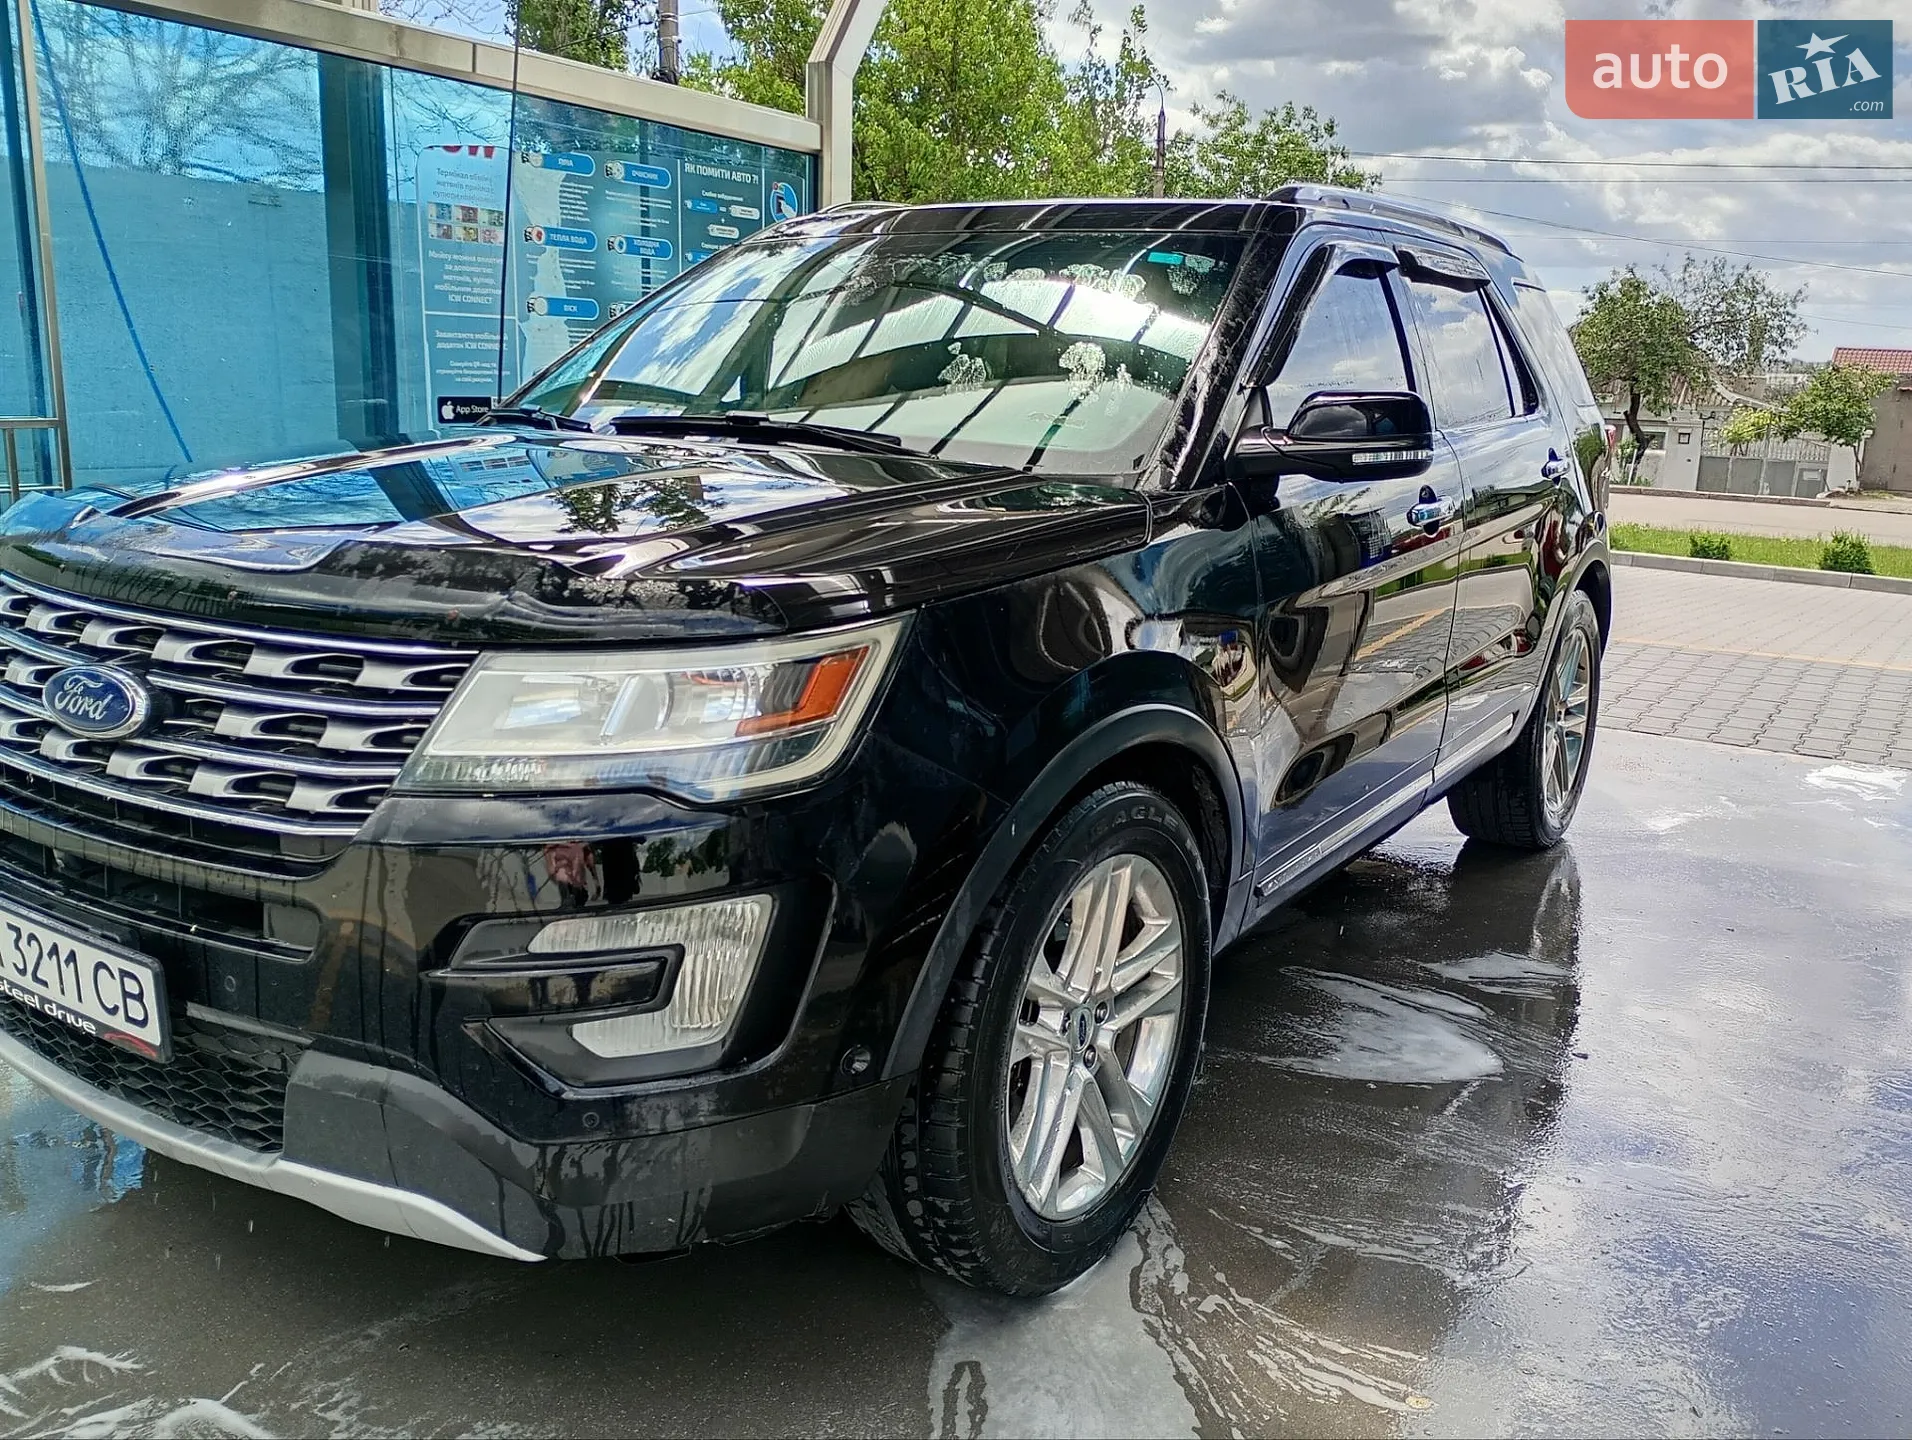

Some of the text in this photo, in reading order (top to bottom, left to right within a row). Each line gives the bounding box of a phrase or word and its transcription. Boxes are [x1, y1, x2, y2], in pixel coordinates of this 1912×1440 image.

[684, 162, 696, 174] ЯК
[696, 165, 731, 180] ПОМИТИ
[731, 170, 751, 184] АВТО
[550, 233, 588, 245] ТЕПЛА ВОДА
[456, 406, 471, 414] App
[55, 674, 114, 720] Ford
[7, 922, 149, 1029] 3211 CB
[44, 1002, 97, 1035] drive
